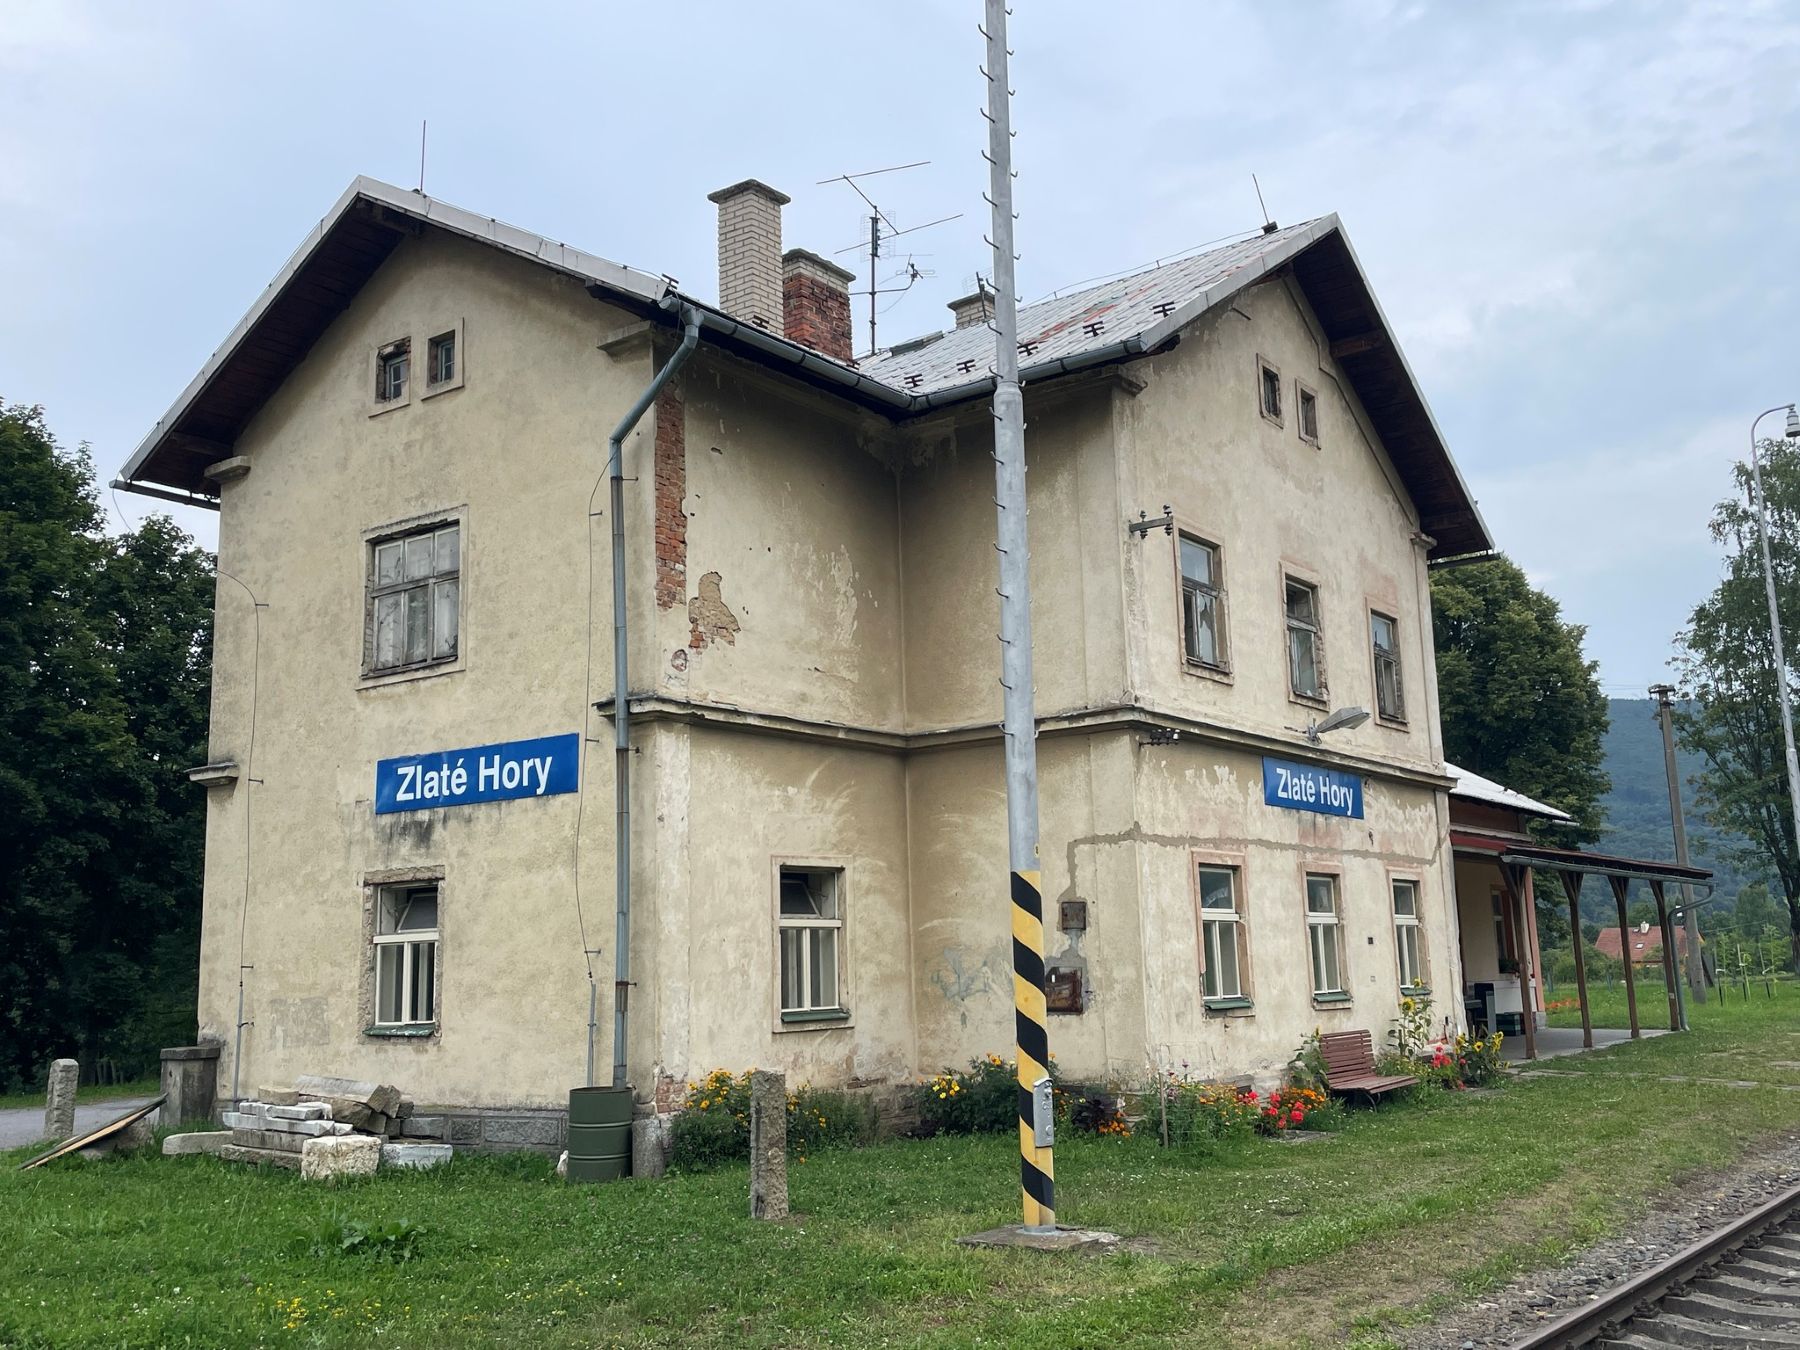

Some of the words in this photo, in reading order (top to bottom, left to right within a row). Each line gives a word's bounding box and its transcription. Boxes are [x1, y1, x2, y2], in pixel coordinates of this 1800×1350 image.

[396, 758, 468, 801] Zlaté
[478, 754, 553, 795] Hory
[1276, 767, 1316, 803] Zlaté
[1319, 775, 1353, 816] Hory
